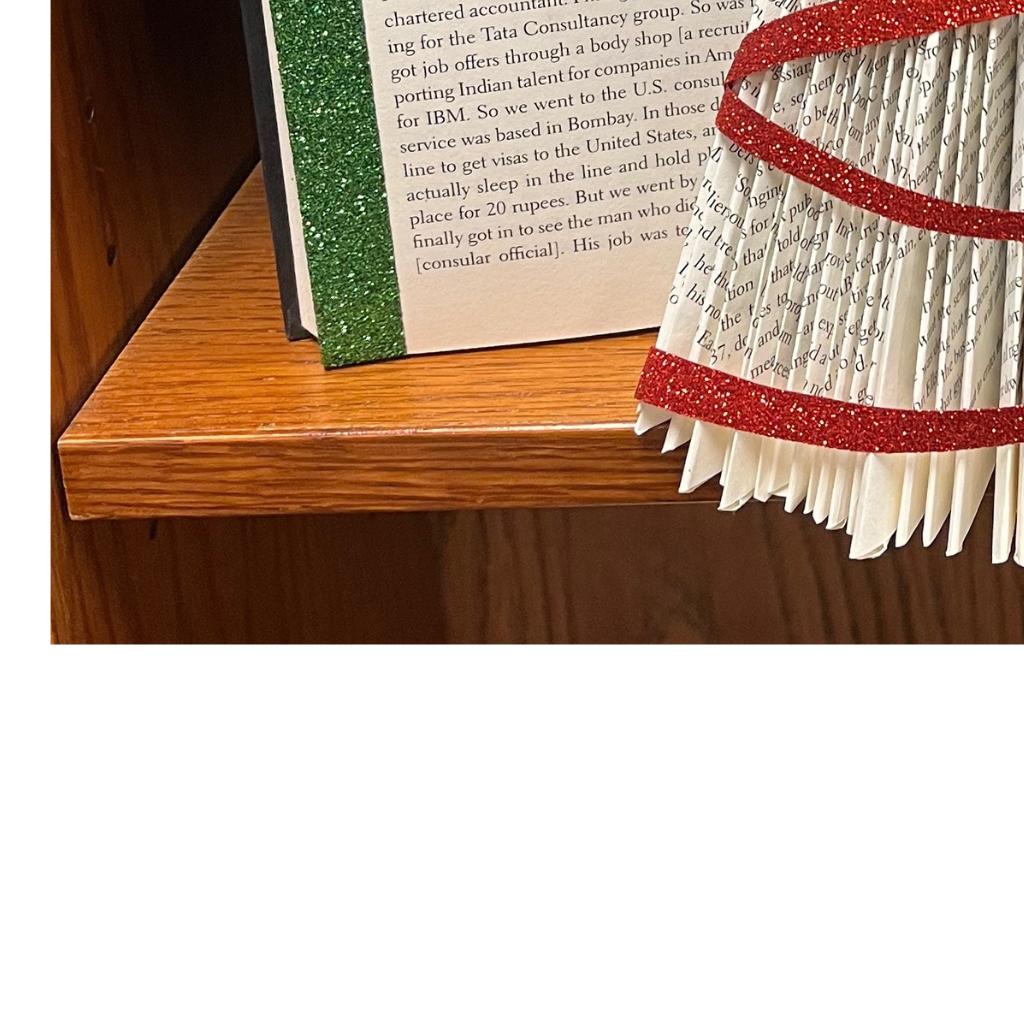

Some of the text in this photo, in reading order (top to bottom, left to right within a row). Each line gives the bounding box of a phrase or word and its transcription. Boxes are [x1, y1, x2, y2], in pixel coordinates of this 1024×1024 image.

[402, 128, 697, 178] line to get visas to the United States,
[409, 174, 698, 230] place for 20 rupees. But we went by
[416, 230, 668, 275] [consular official]. His job was
